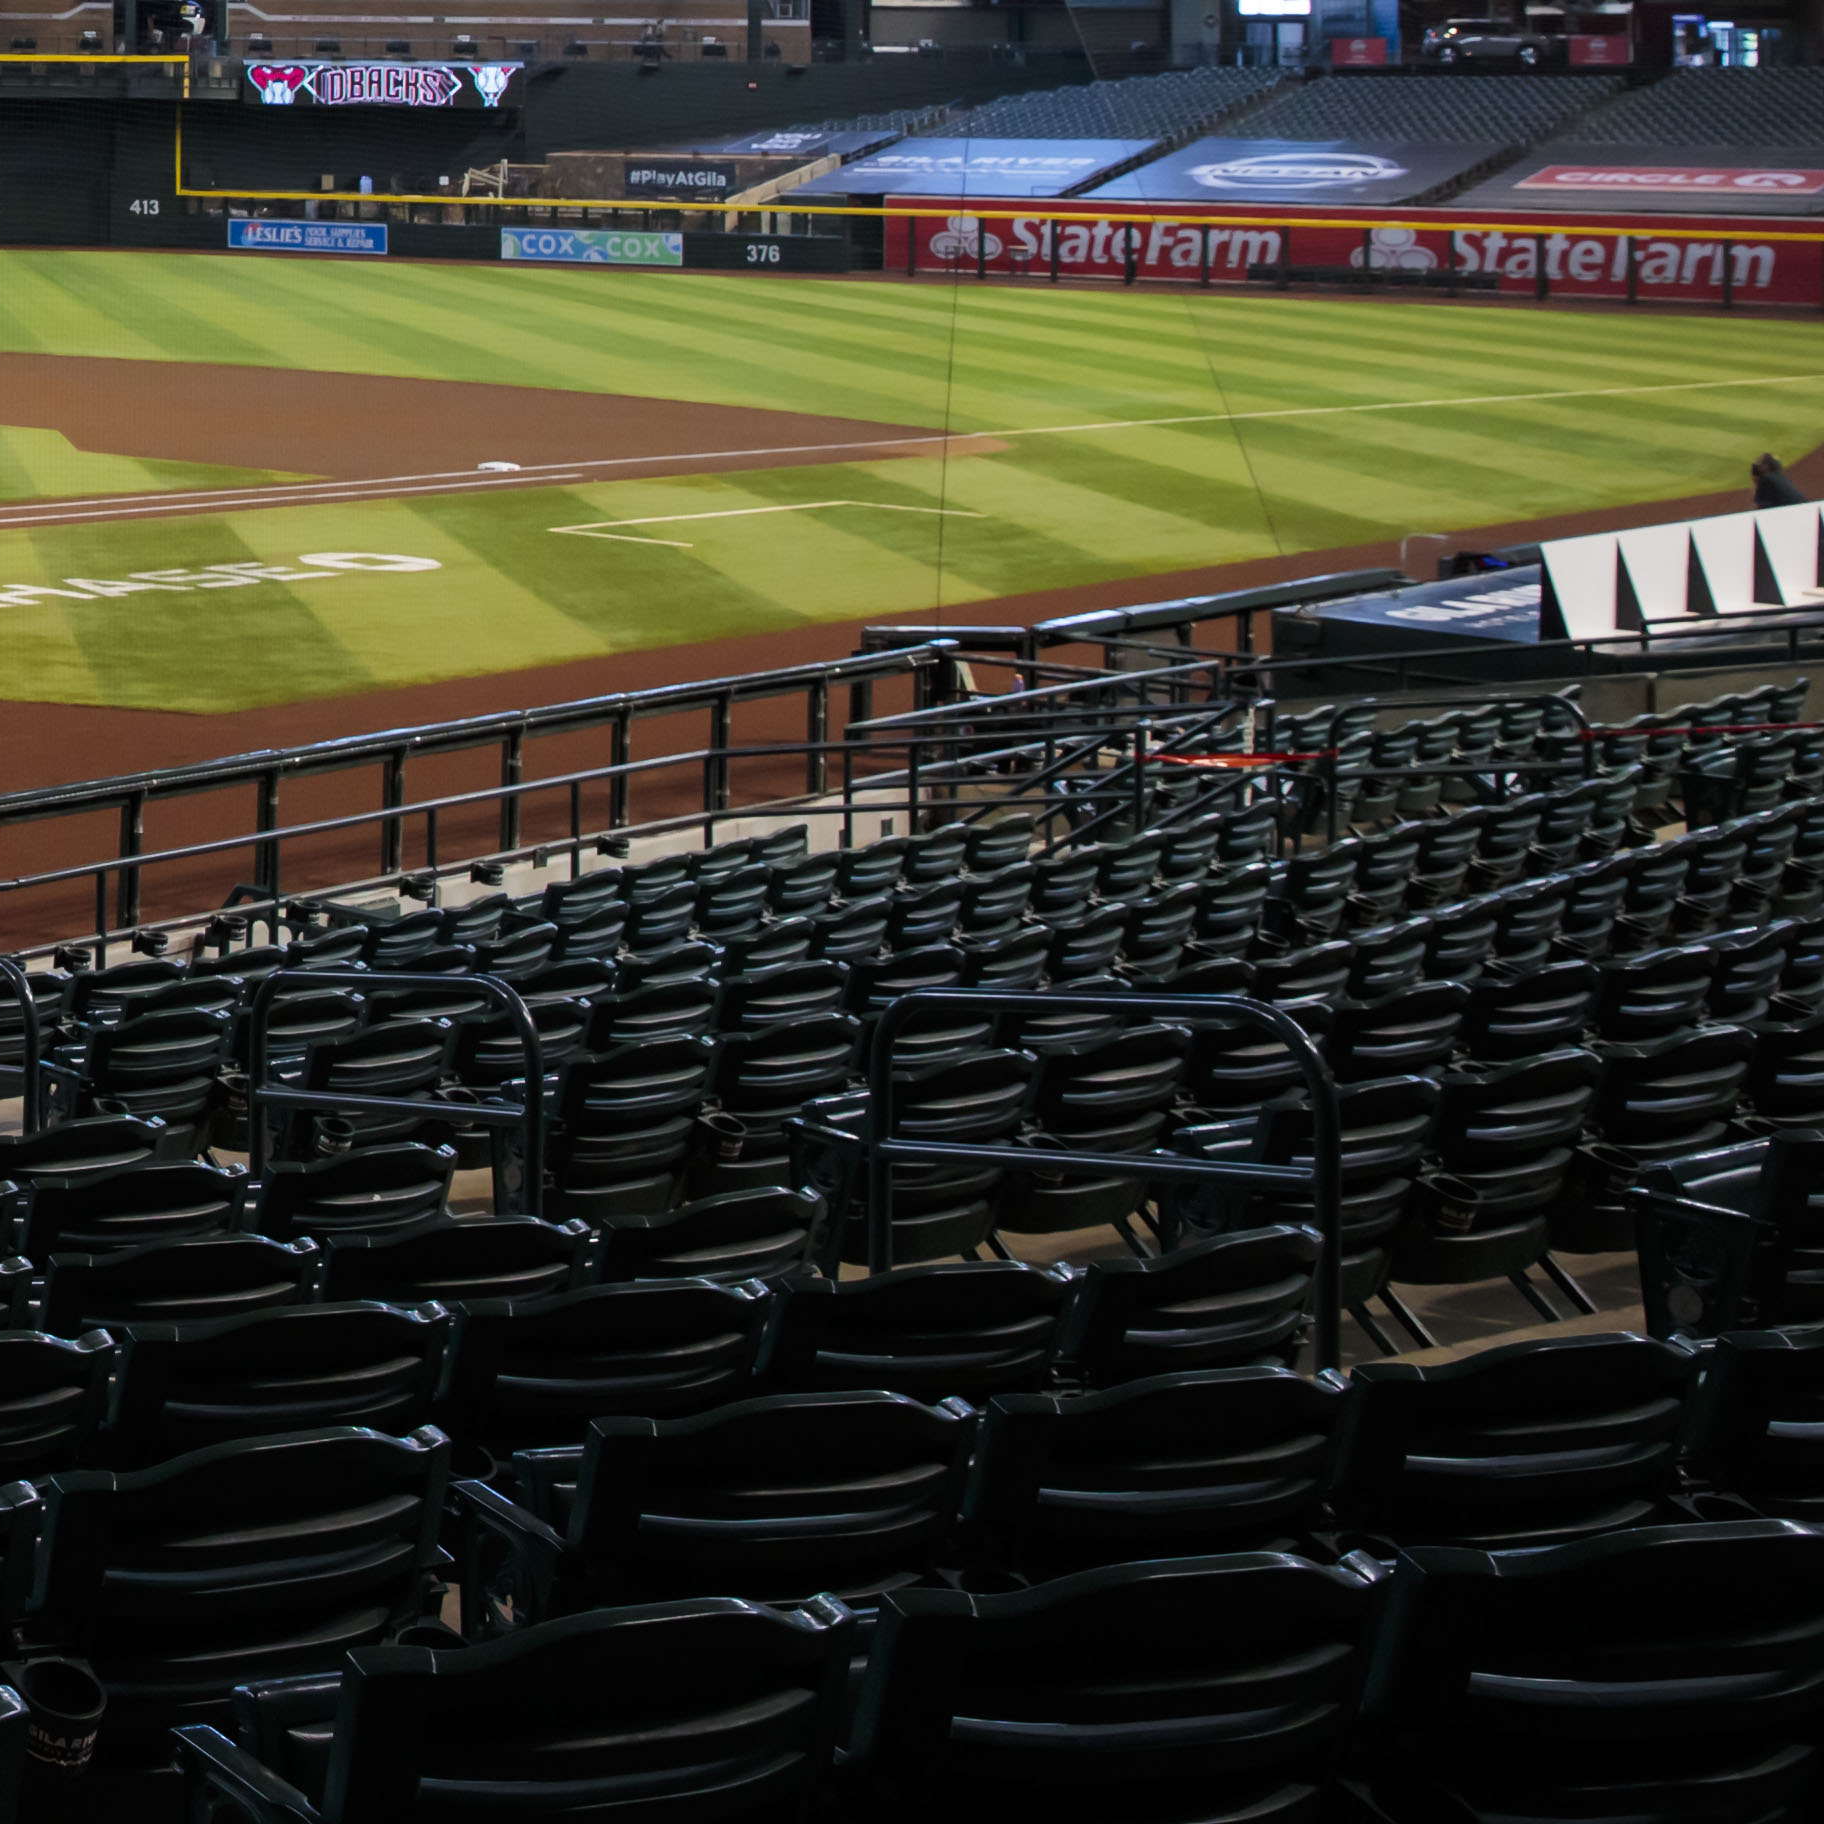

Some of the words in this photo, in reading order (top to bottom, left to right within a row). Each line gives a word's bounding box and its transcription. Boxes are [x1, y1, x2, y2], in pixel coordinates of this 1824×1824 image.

[630, 170, 726, 187] #PlayAtGila
[1556, 173, 1720, 184] CIRCLE
[131, 200, 160, 214] 413
[522, 234, 575, 255] COX
[606, 237, 660, 257] COX
[747, 245, 779, 262] 376
